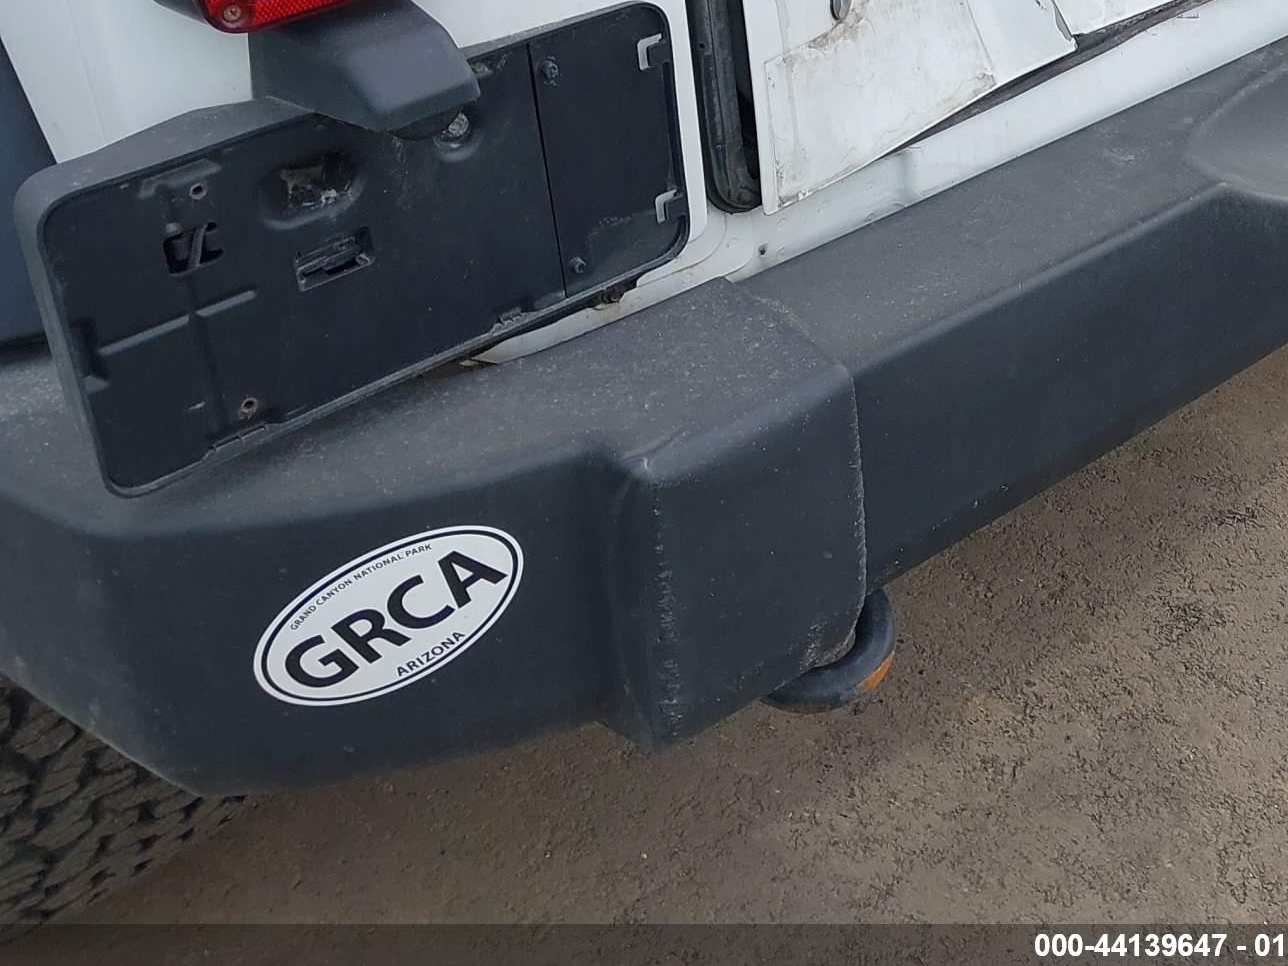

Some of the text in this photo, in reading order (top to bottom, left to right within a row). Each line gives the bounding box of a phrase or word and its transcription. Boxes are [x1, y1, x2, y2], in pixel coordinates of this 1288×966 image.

[284, 550, 509, 688] GRCA
[290, 543, 433, 631] GRAND CANYON NATIONAL PARK
[396, 631, 466, 677] ARIZONA
